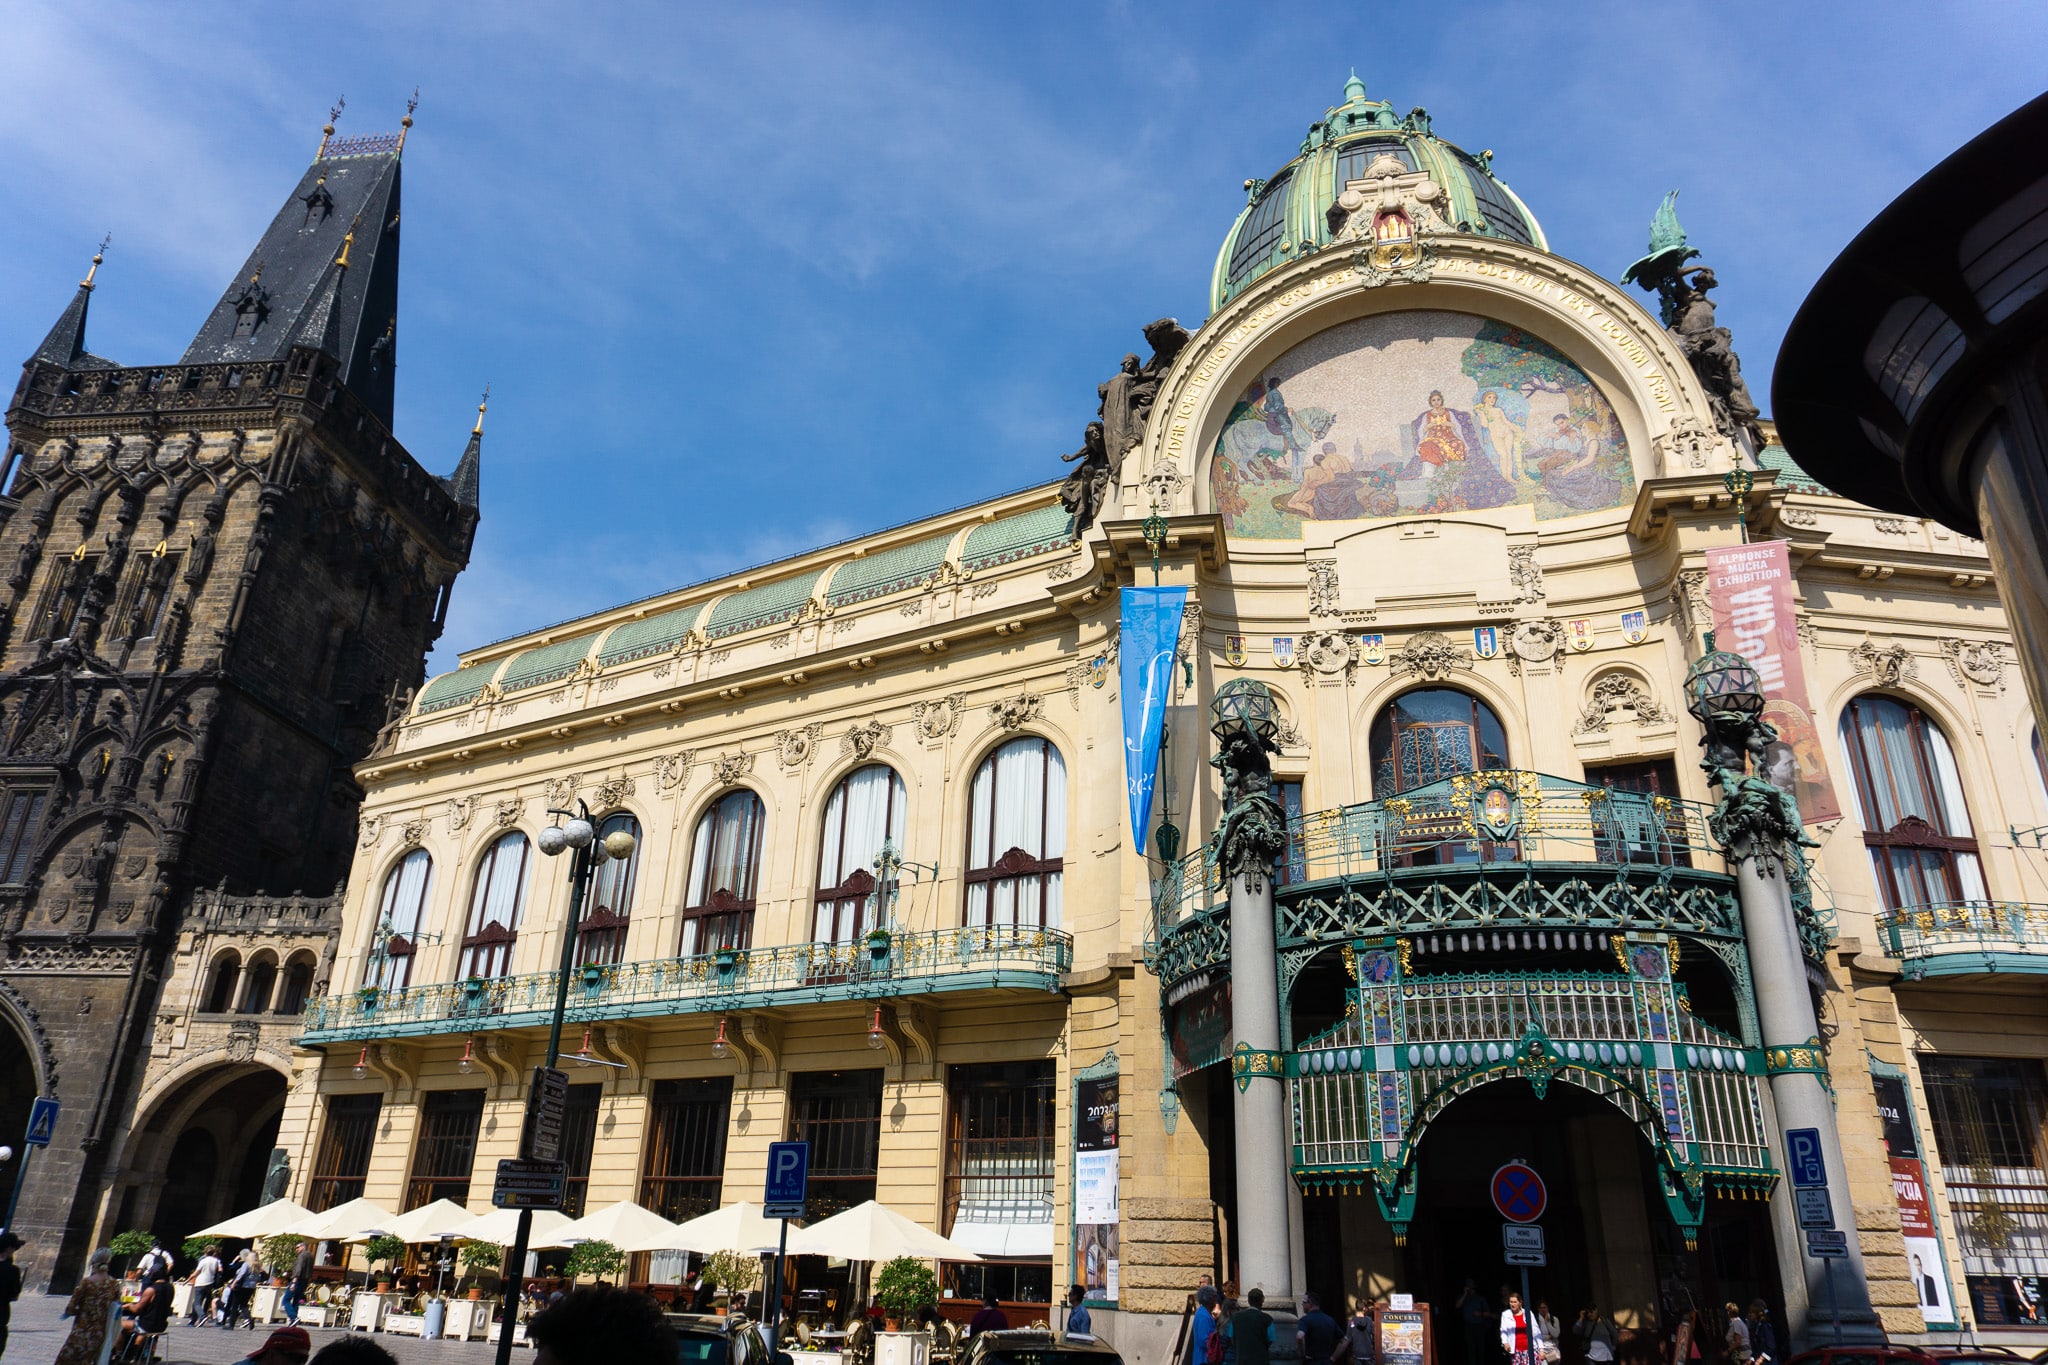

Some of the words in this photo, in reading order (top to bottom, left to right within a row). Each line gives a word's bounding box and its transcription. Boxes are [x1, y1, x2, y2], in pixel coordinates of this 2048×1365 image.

[1437, 258, 1471, 272] JAK
[1718, 548, 1776, 565] ALPHONSE
[1727, 560, 1768, 574] MUCHA
[1717, 568, 1781, 588] EXHIBITION
[1793, 1136, 1813, 1169] P
[775, 1150, 799, 1184] P
